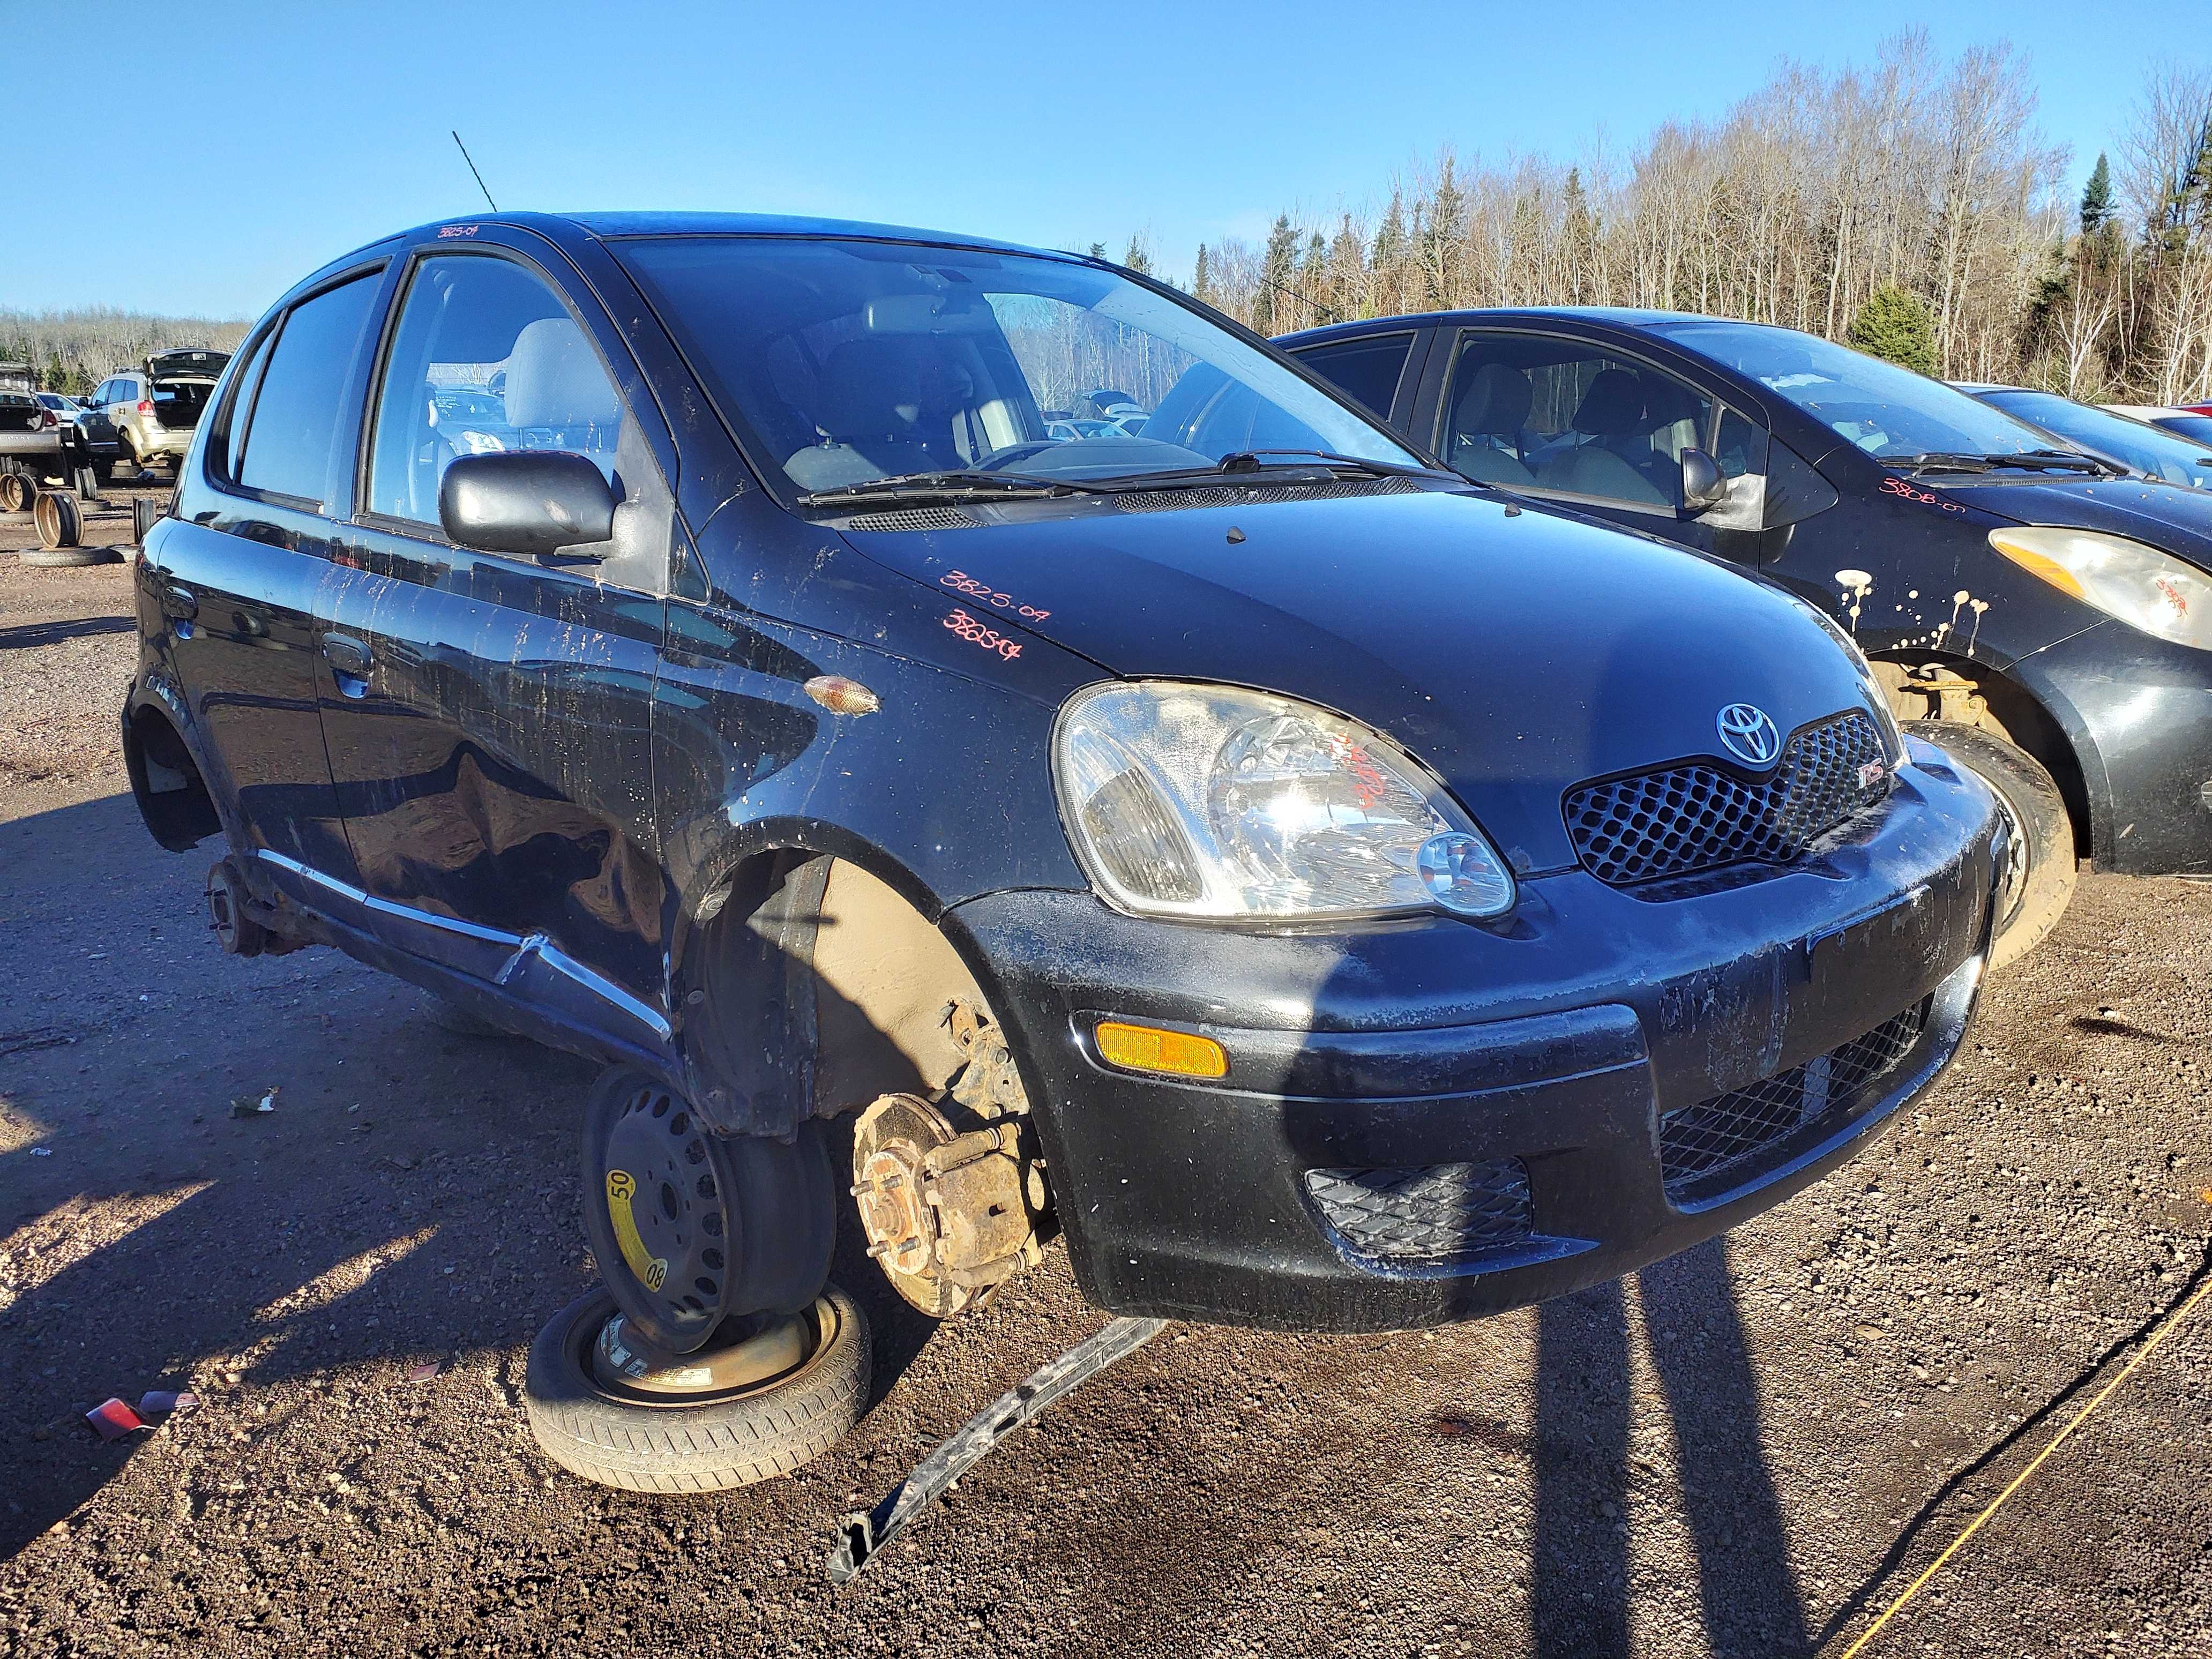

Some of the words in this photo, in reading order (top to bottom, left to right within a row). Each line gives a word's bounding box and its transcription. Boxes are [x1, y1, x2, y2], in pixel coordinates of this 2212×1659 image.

[1857, 757, 1884, 789] RS
[611, 1172, 629, 1200] 50
[737, 1339, 860, 1415] TEMPORARY
[651, 1410, 706, 1424] USE
